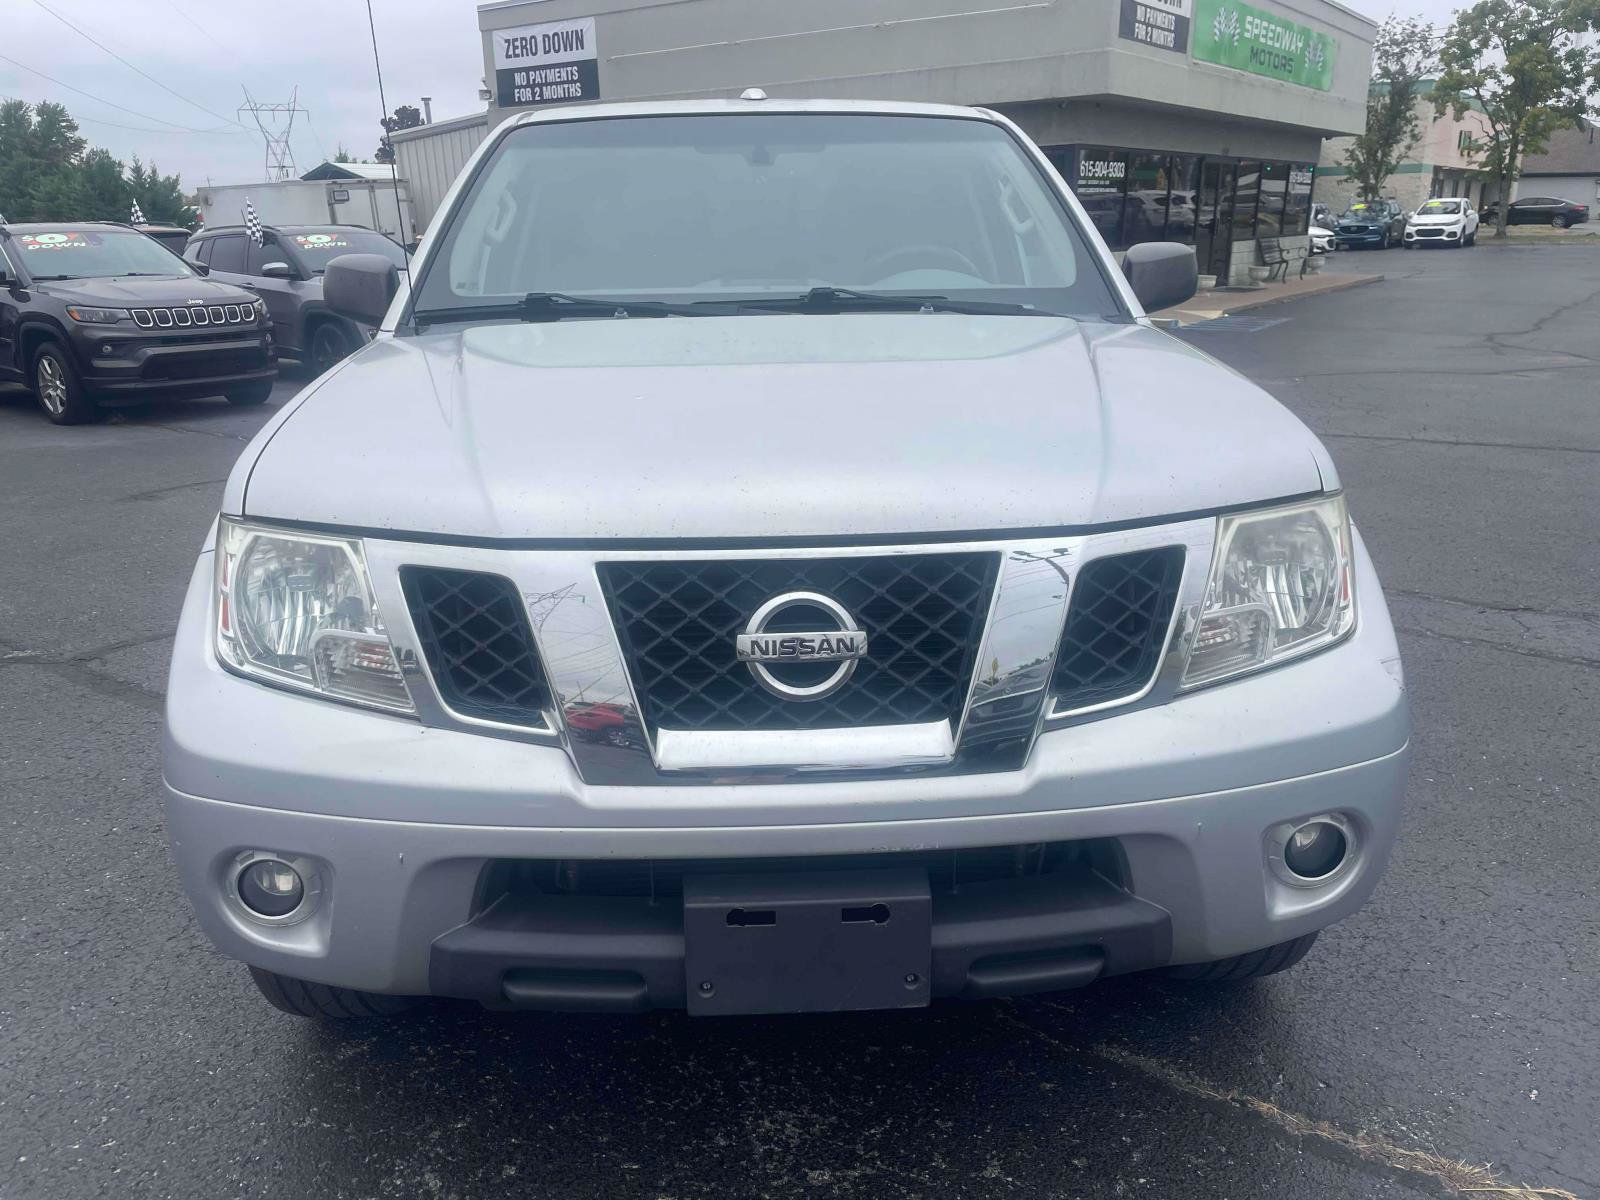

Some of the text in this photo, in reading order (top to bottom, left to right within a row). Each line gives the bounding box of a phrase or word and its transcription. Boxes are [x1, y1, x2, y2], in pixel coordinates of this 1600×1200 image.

[1136, 4, 1176, 30] NO PAYMENTS
[504, 29, 585, 59] ZERO DOWN
[1134, 22, 1176, 48] FOR 2 MONTHS
[1244, 16, 1304, 54] SPEEDWAY
[1250, 45, 1294, 74] MOTORS
[514, 66, 578, 86] NO PAYMENTS
[514, 82, 582, 102] FOR 2 MONTHS
[1080, 160, 1125, 178] 615-904-9303
[751, 638, 855, 656] NISSAN
